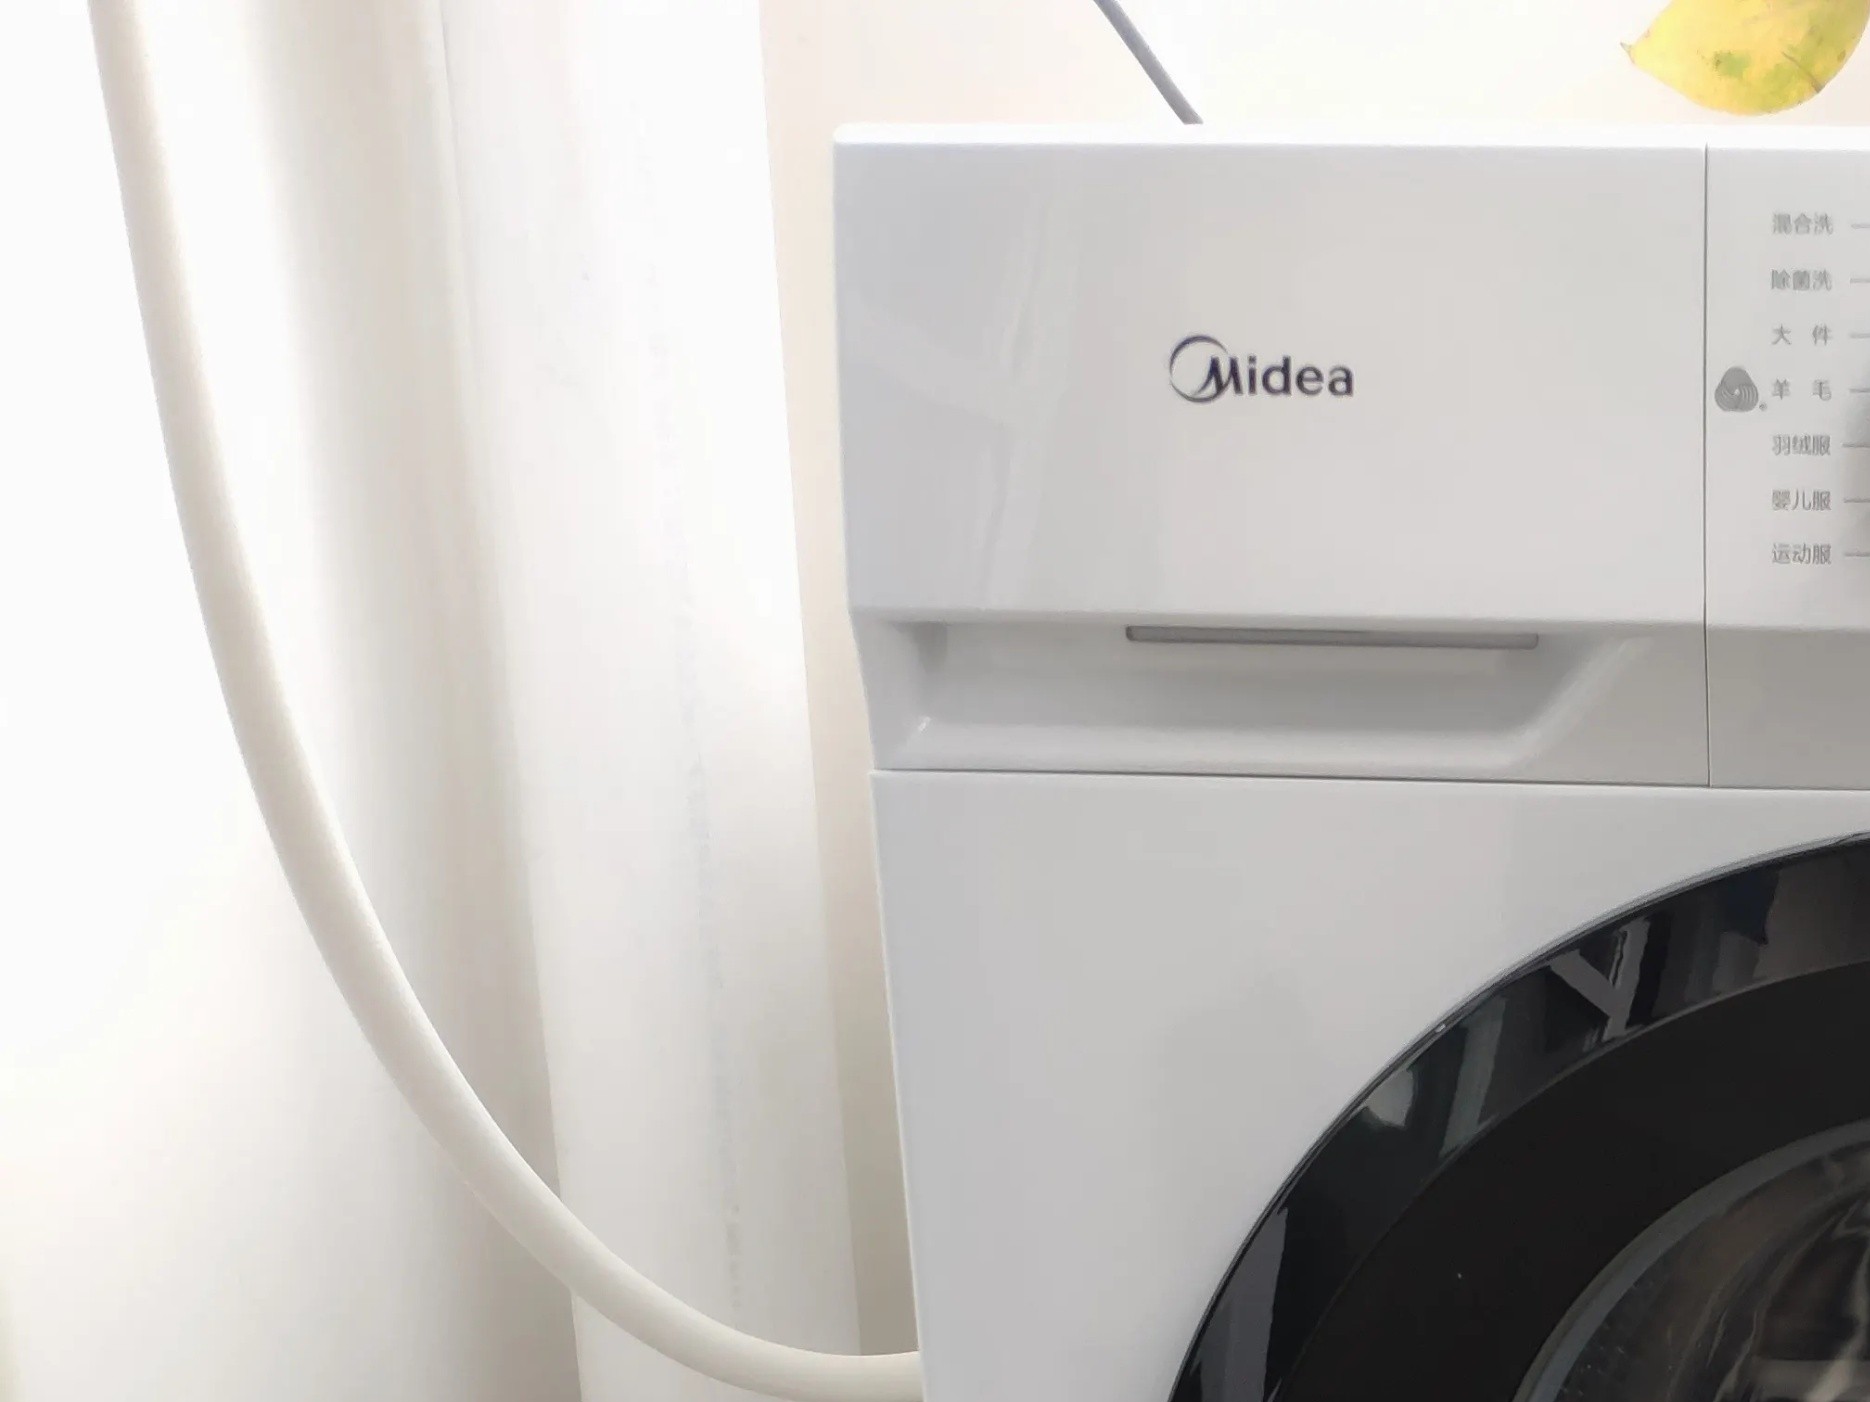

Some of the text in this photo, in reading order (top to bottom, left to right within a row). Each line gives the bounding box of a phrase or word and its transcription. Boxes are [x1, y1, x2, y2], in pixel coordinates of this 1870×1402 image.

[1772, 213, 1834, 235] 混合洗
[1771, 268, 1832, 291] 除菌洗
[1169, 334, 1354, 404] Midea
[1772, 434, 1832, 456] 羽绒服
[1772, 489, 1832, 511] 婴儿服
[1772, 543, 1832, 565] 运动服
